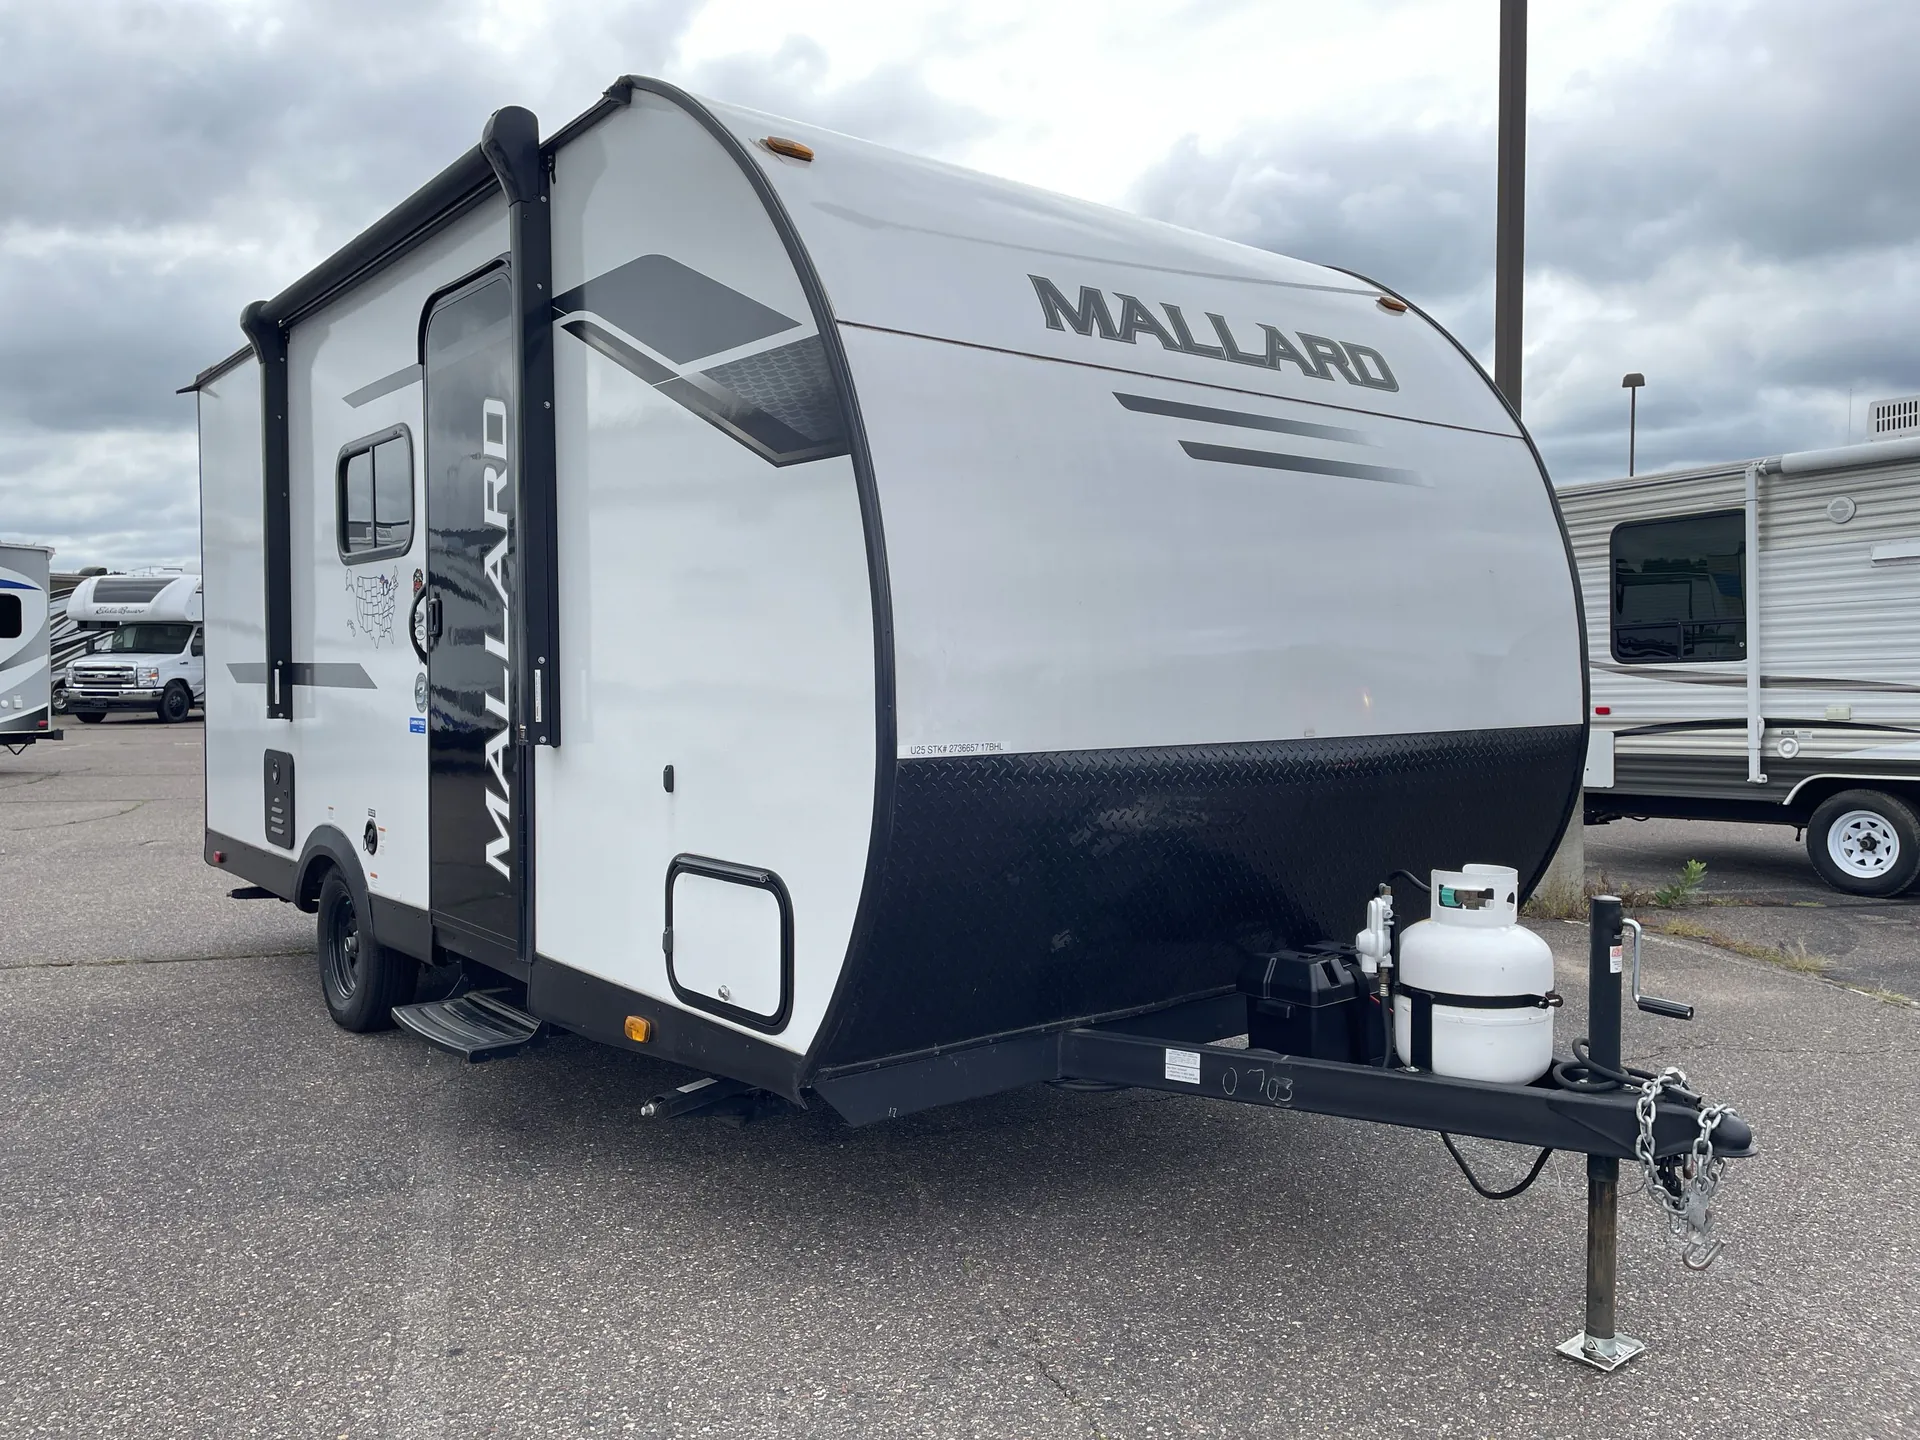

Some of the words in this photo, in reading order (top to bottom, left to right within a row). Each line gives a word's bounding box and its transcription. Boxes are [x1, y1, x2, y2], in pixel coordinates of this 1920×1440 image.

[1027, 273, 1399, 392] MALLARD
[483, 397, 510, 881] MALLARD
[910, 745, 926, 755] U25
[927, 743, 947, 754] STK#
[948, 743, 979, 753] 2736657
[981, 742, 1004, 752] 17BHL
